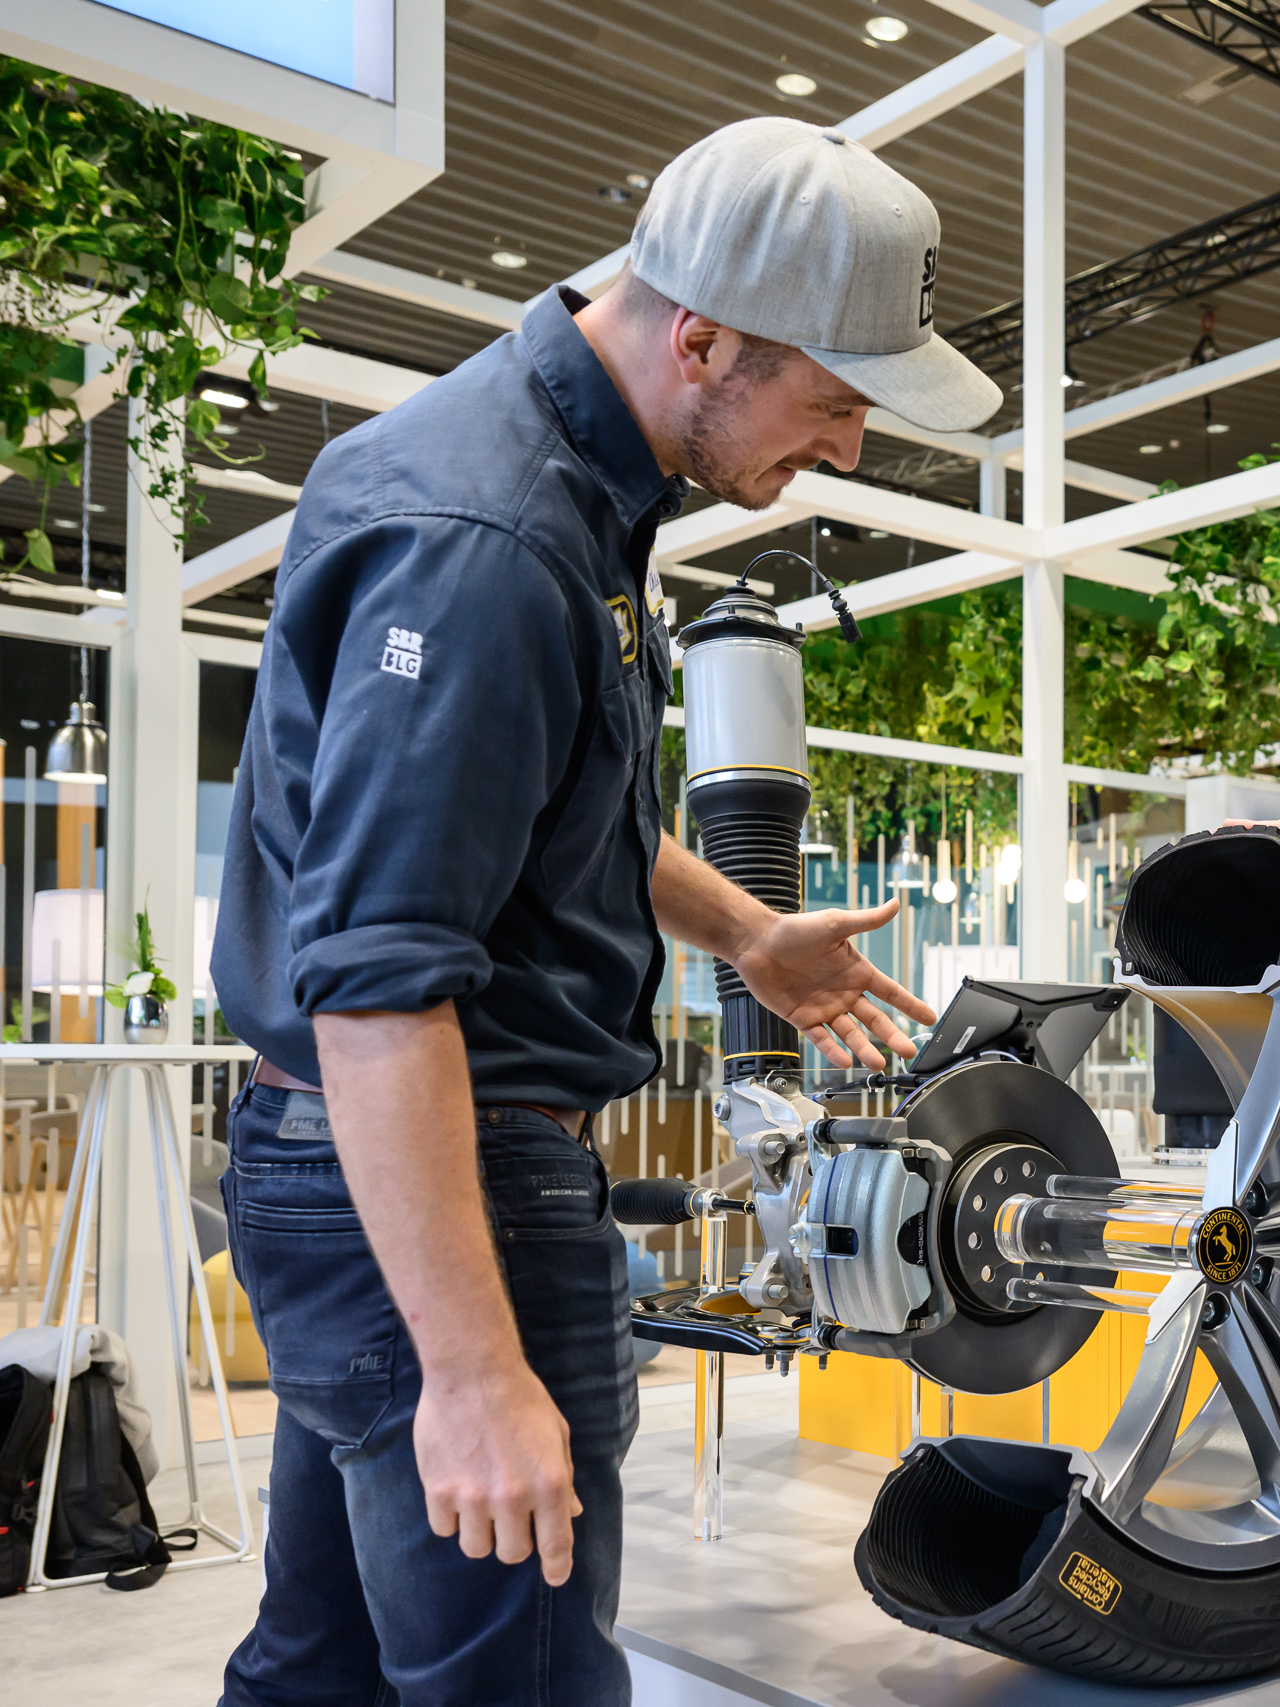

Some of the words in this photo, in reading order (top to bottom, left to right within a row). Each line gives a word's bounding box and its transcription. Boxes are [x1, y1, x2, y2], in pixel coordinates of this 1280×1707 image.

[386, 626, 424, 655] SBR
[383, 649, 420, 676] BLG
[1203, 1212, 1245, 1238] CONTINENTAL
[1207, 1264, 1227, 1280] SINCE
[1228, 1261, 1242, 1277] 1871
[1072, 1566, 1111, 1602] Recycled
[1078, 1557, 1116, 1591] Material
[1068, 1575, 1105, 1609] Contains
